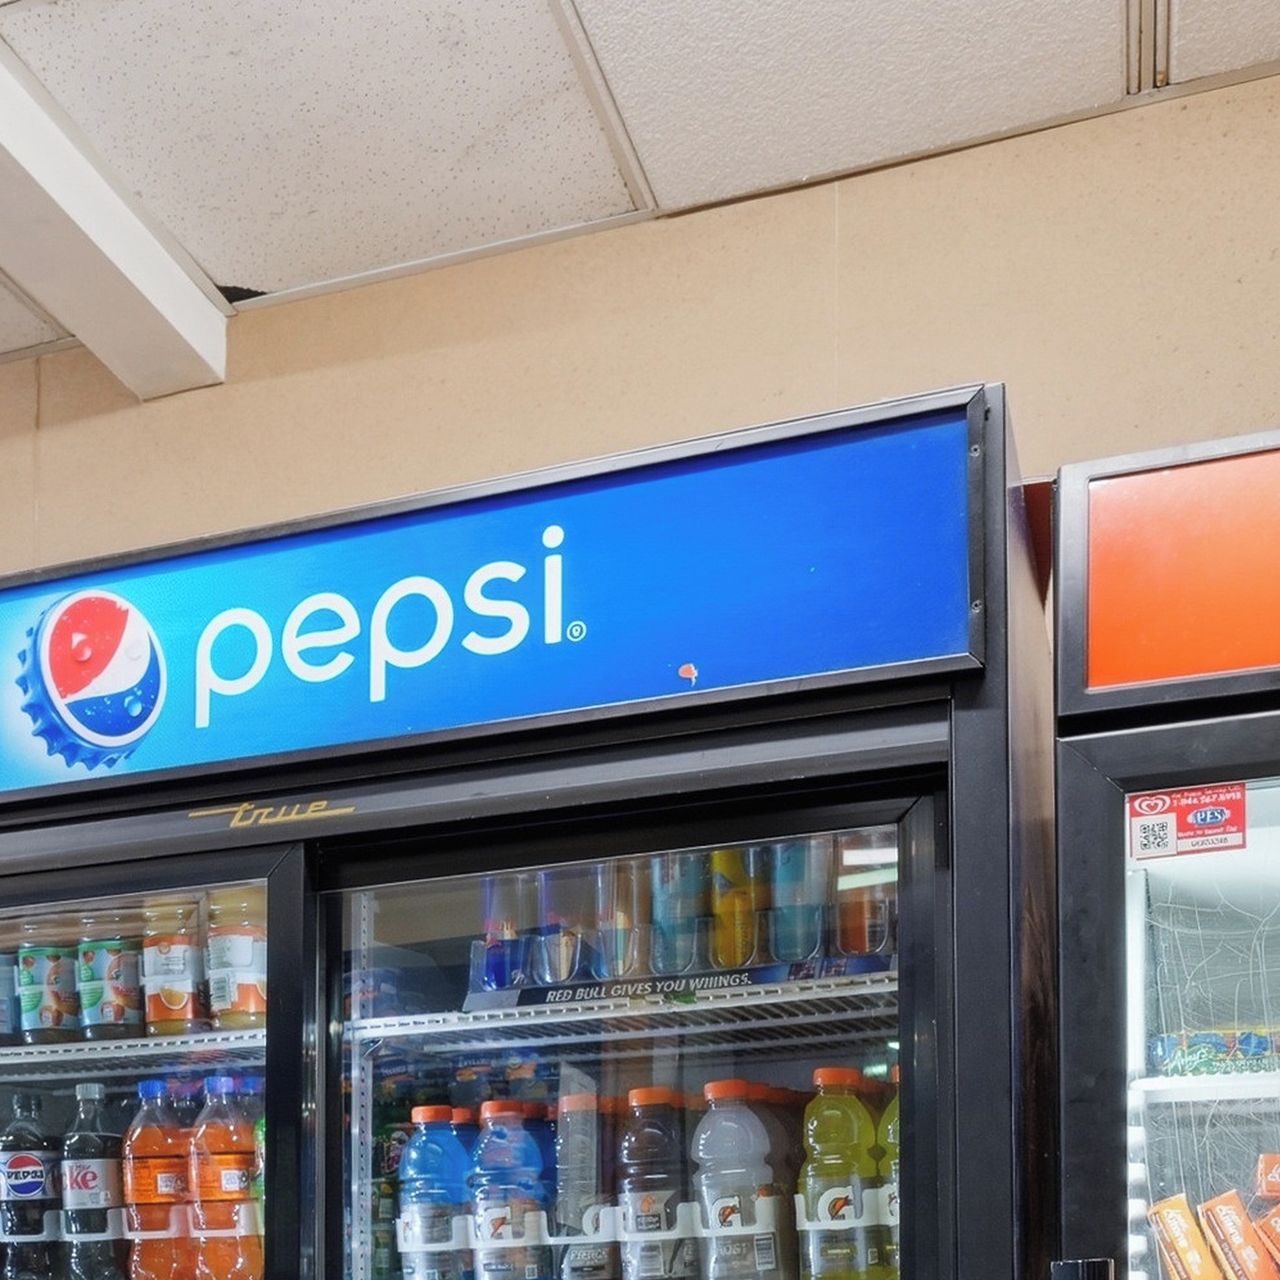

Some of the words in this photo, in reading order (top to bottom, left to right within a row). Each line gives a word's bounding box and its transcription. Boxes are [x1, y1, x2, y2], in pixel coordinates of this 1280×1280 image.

[195, 525, 564, 729] pepsi
[198, 801, 346, 829] true
[546, 989, 572, 1002] RED
[575, 987, 607, 1000] BULL
[611, 982, 652, 997] GIVES
[655, 979, 686, 992] YOU
